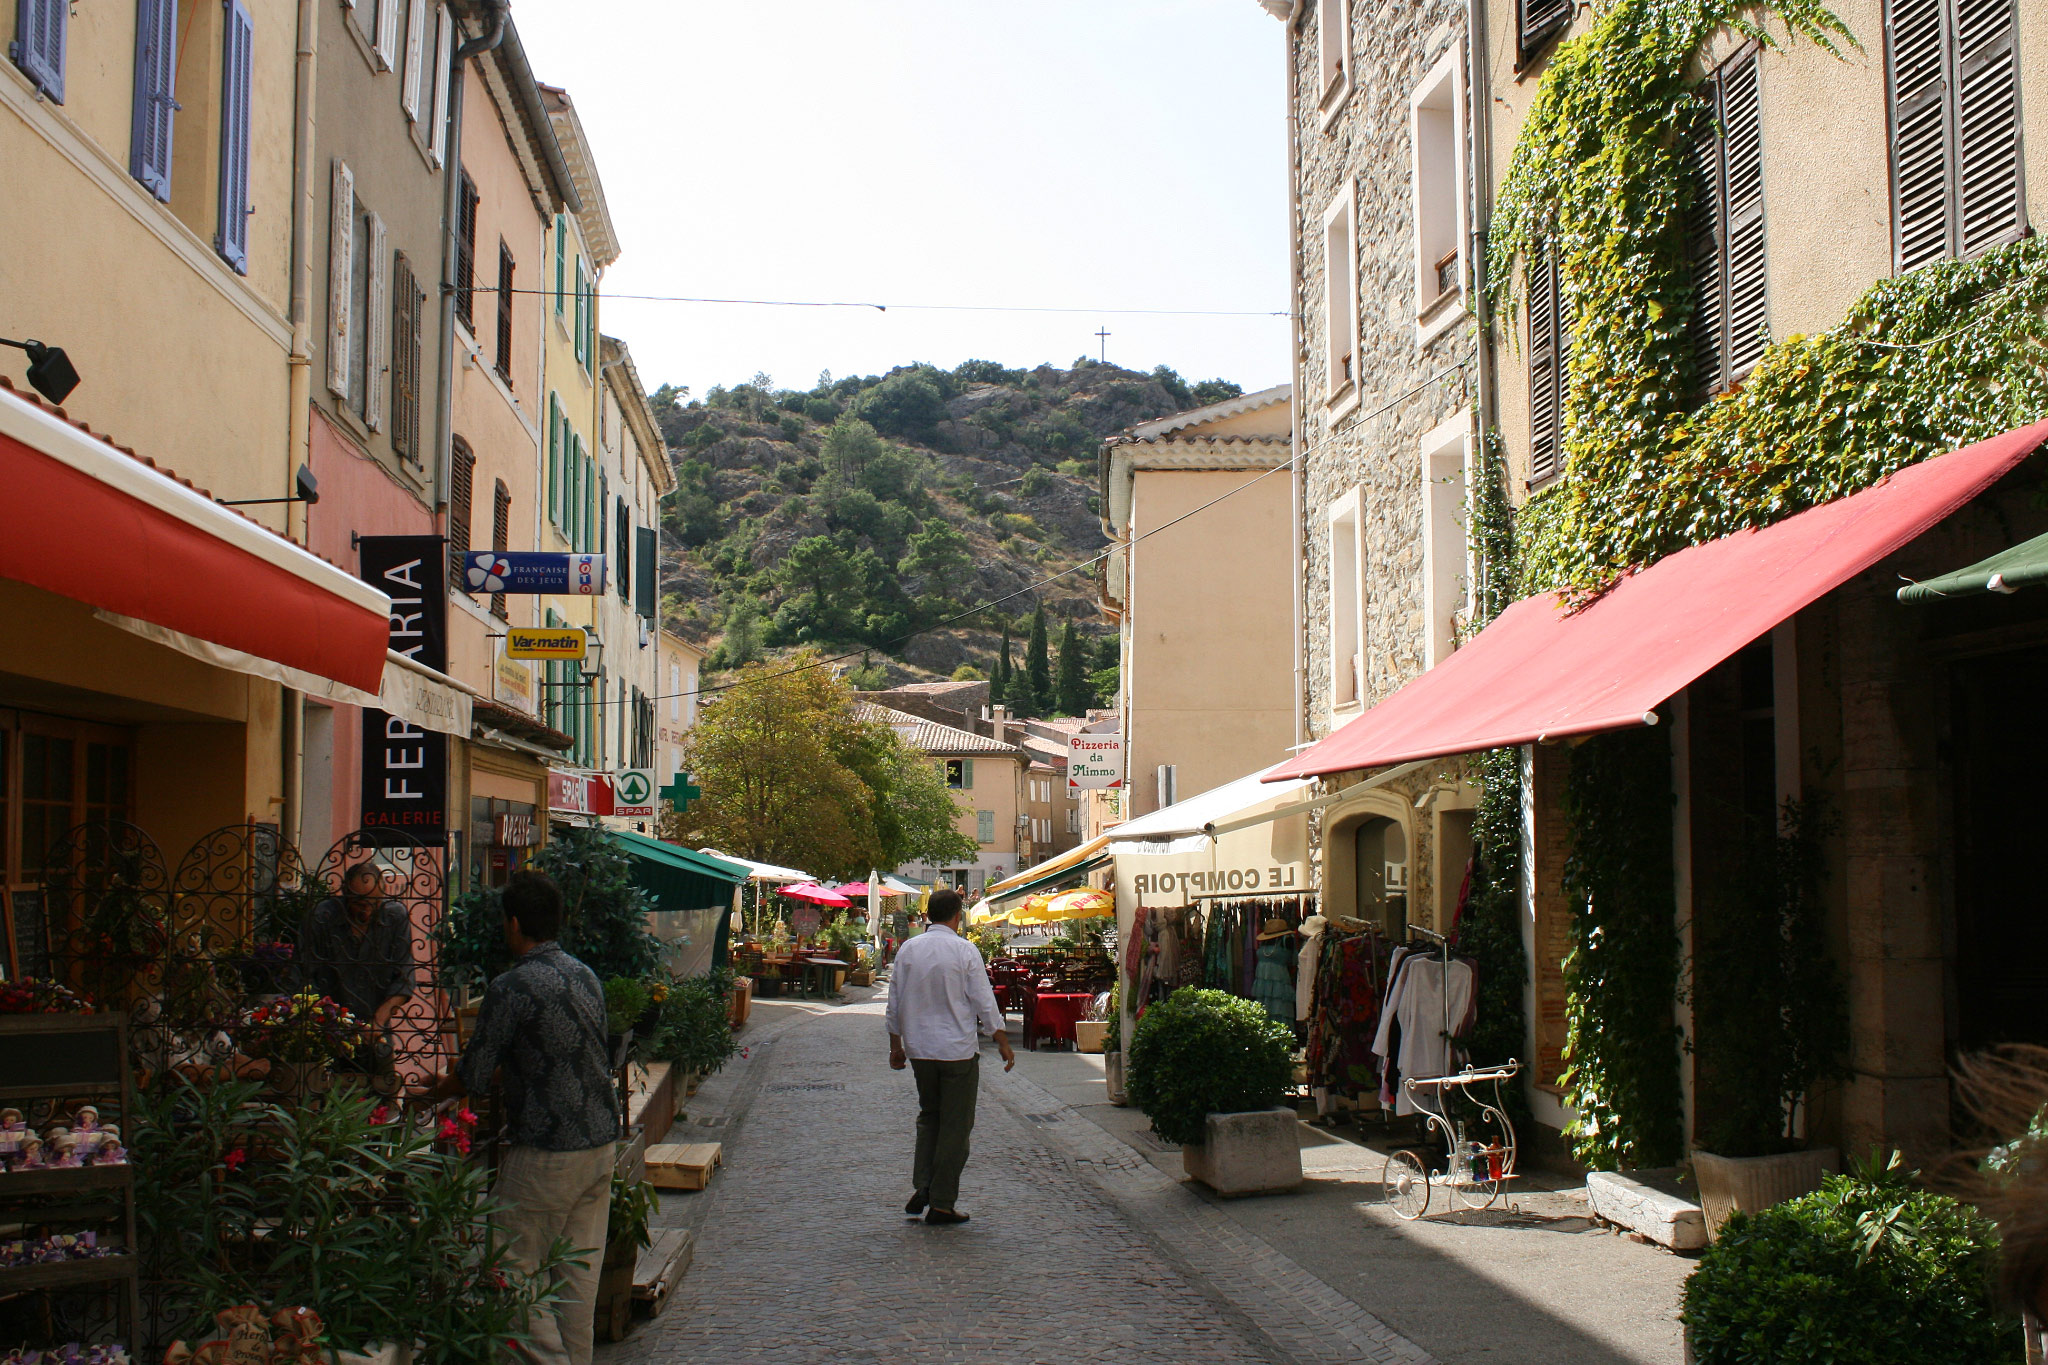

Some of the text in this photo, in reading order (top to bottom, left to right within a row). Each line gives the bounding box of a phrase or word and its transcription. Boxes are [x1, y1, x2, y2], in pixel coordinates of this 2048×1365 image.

[539, 577, 564, 585] JEUX
[579, 555, 593, 594] LOTO
[512, 635, 579, 649] Var-matin
[383, 558, 424, 799] FERRIA
[1071, 738, 1119, 750] Pizzeria
[1089, 753, 1103, 762] da
[1072, 764, 1116, 777] Mimmo
[364, 810, 442, 825] GALERIE
[616, 807, 652, 815] SPAR
